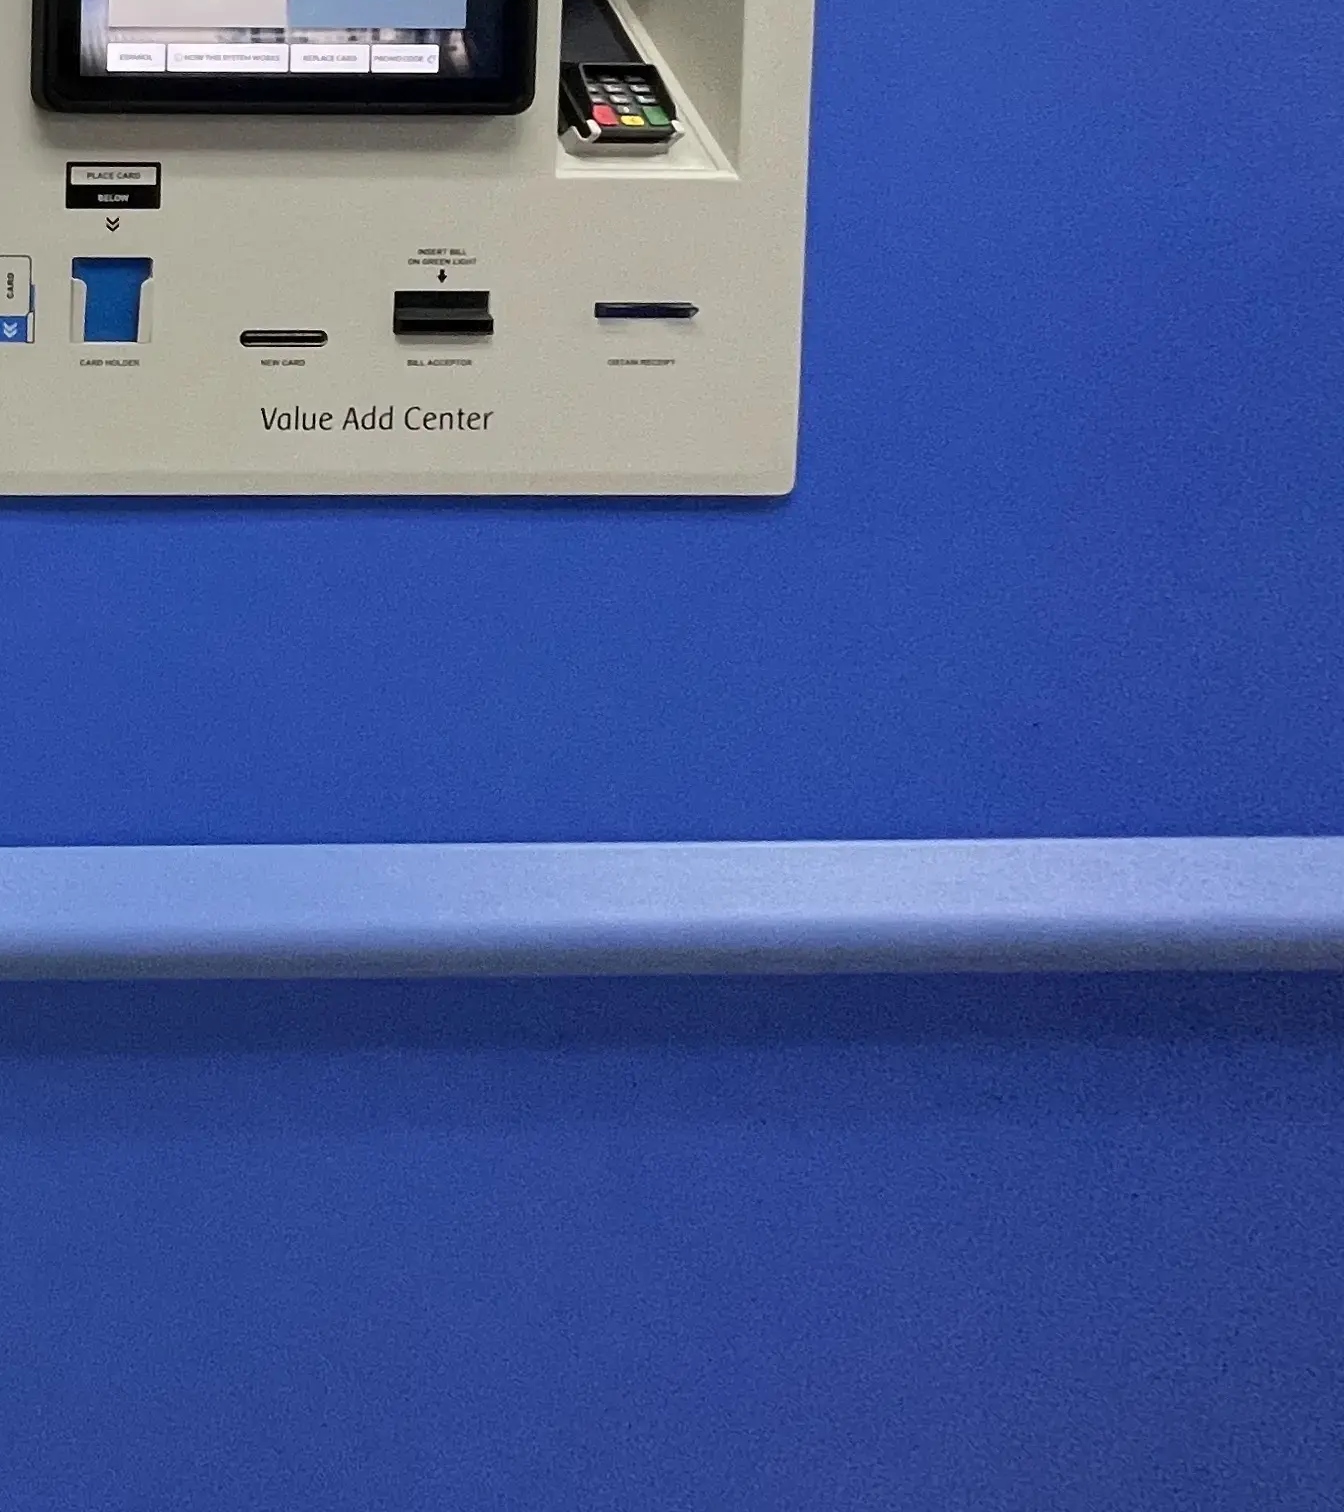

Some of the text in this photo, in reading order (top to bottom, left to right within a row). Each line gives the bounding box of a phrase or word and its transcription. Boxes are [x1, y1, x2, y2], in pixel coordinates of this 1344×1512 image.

[85, 171, 141, 181] PLACE CARD
[6, 272, 15, 300] CARD
[259, 405, 493, 431] Value Add Center
